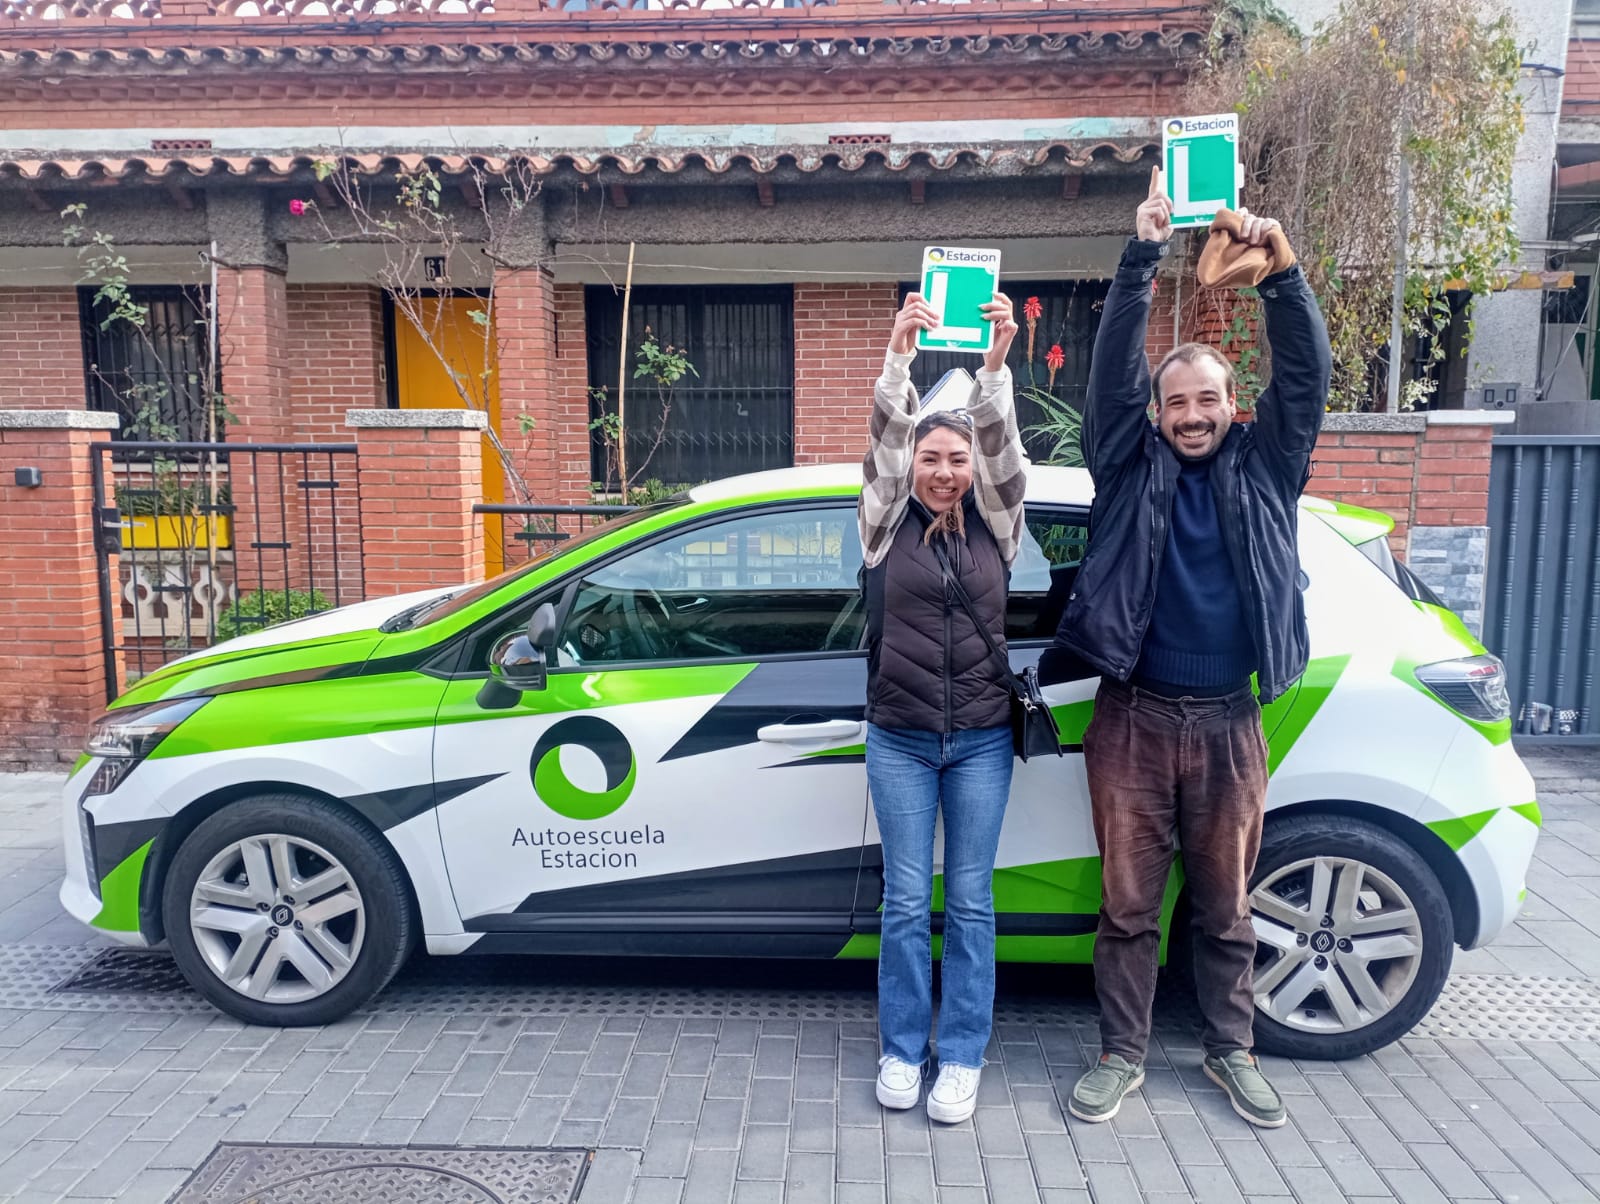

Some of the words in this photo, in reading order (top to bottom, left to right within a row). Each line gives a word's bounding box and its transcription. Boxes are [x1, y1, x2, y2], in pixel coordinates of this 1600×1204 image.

[1185, 118, 1235, 132] Estacion
[1173, 145, 1227, 218] L
[946, 250, 997, 263] Estacion
[426, 258, 446, 281] 61
[926, 271, 983, 343] L
[511, 824, 665, 847] Autoescuela
[541, 847, 637, 869] Estacion
